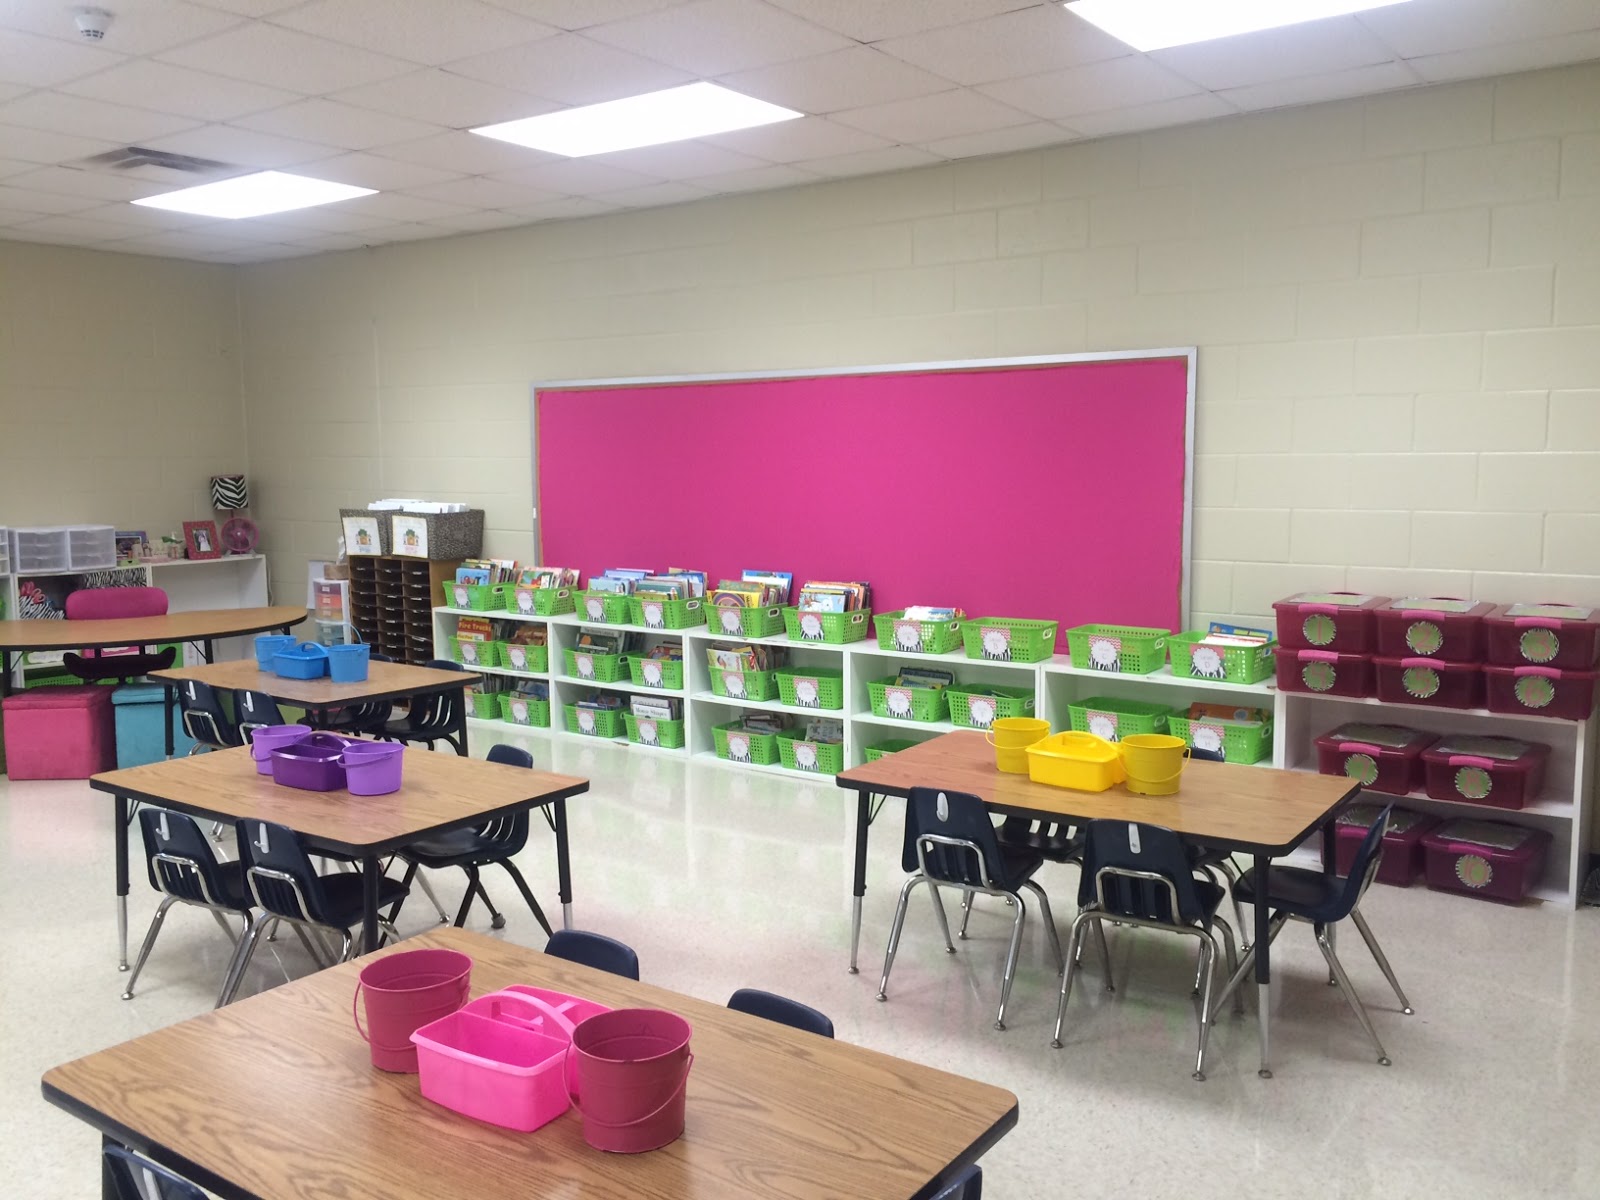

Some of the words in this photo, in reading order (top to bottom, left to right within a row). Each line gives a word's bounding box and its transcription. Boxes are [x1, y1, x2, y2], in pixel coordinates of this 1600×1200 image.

[1317, 620, 1322, 641] 1
[1416, 627, 1432, 649] 2
[1528, 634, 1550, 657] 3
[1311, 665, 1326, 687] 4
[1413, 670, 1430, 692] 5
[1525, 679, 1545, 704] 6
[1354, 759, 1370, 782] 7
[1465, 773, 1482, 796] 8
[1464, 860, 1488, 883] 10
